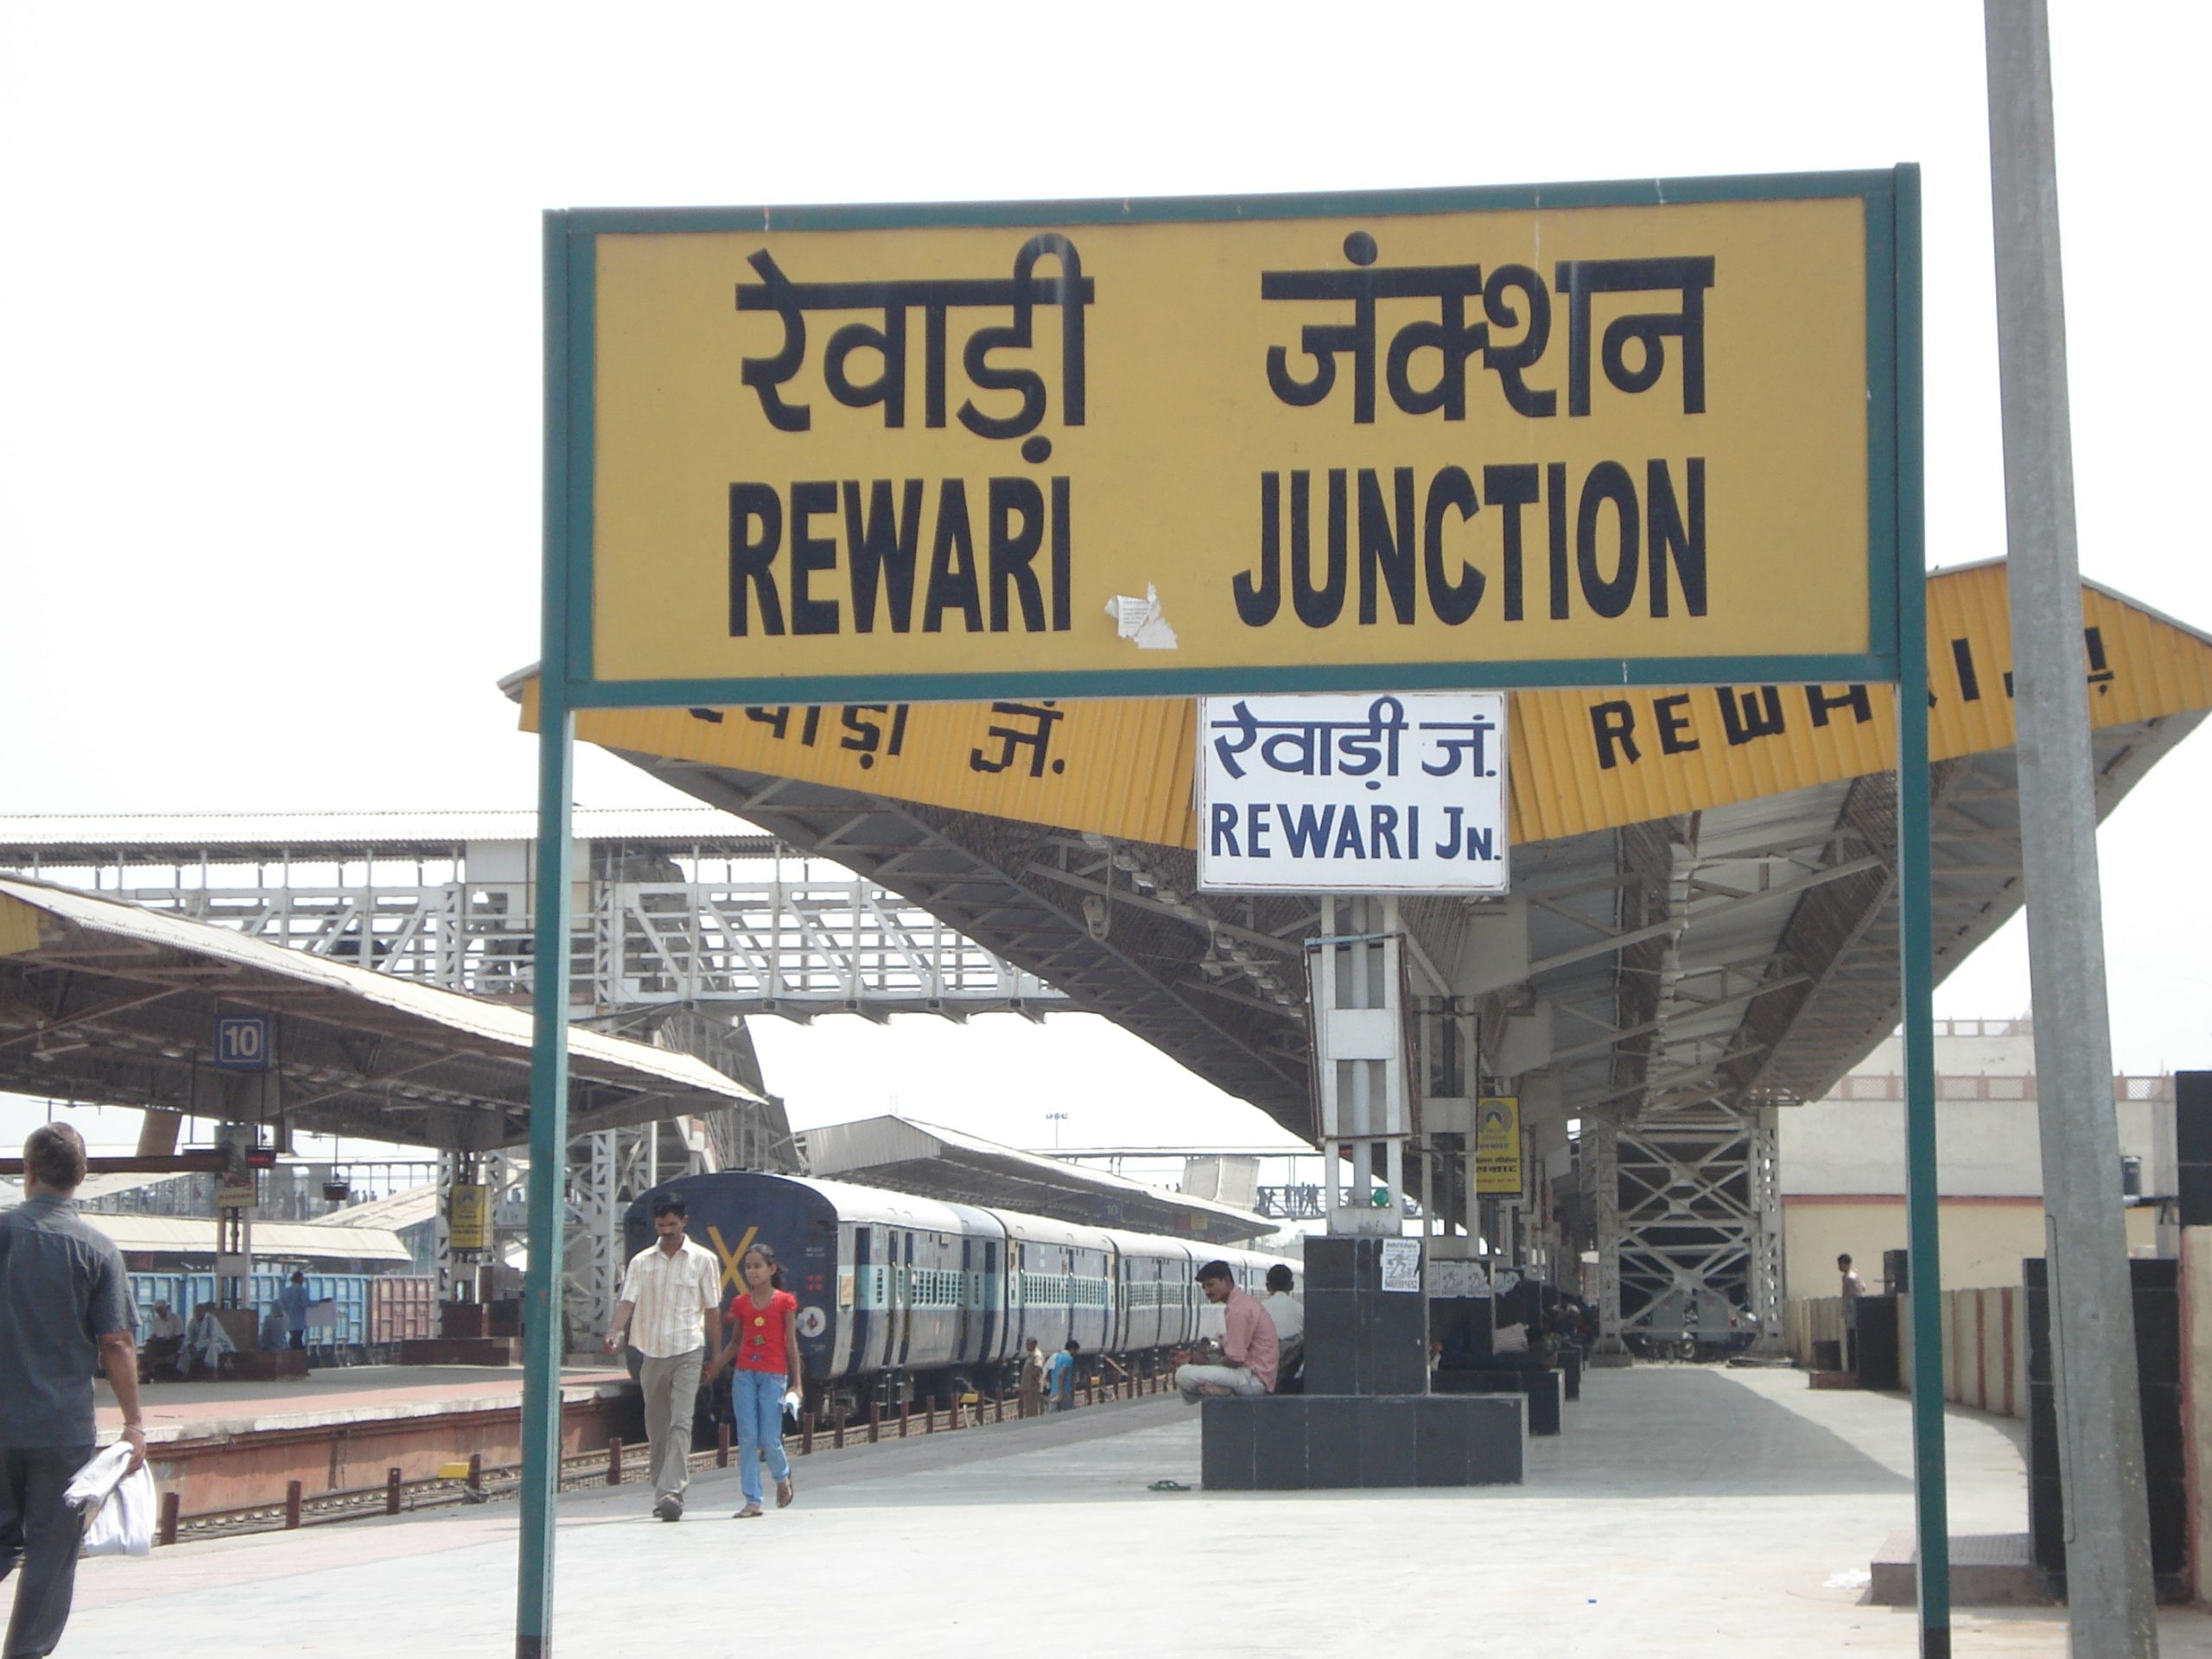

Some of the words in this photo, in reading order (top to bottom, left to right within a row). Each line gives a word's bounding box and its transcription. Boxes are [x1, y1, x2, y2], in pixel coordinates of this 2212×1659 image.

[735, 232, 1094, 464] रेवाड़ी
[1262, 231, 1715, 423] जंक्शन
[728, 476, 1071, 637] REWARI
[1232, 457, 1707, 628] JUNCTION
[1211, 696, 1408, 791] रेवाड़ी
[1589, 638, 1981, 770] REWAI
[1211, 803, 1419, 860] REWARI
[225, 1026, 258, 1056] 10
